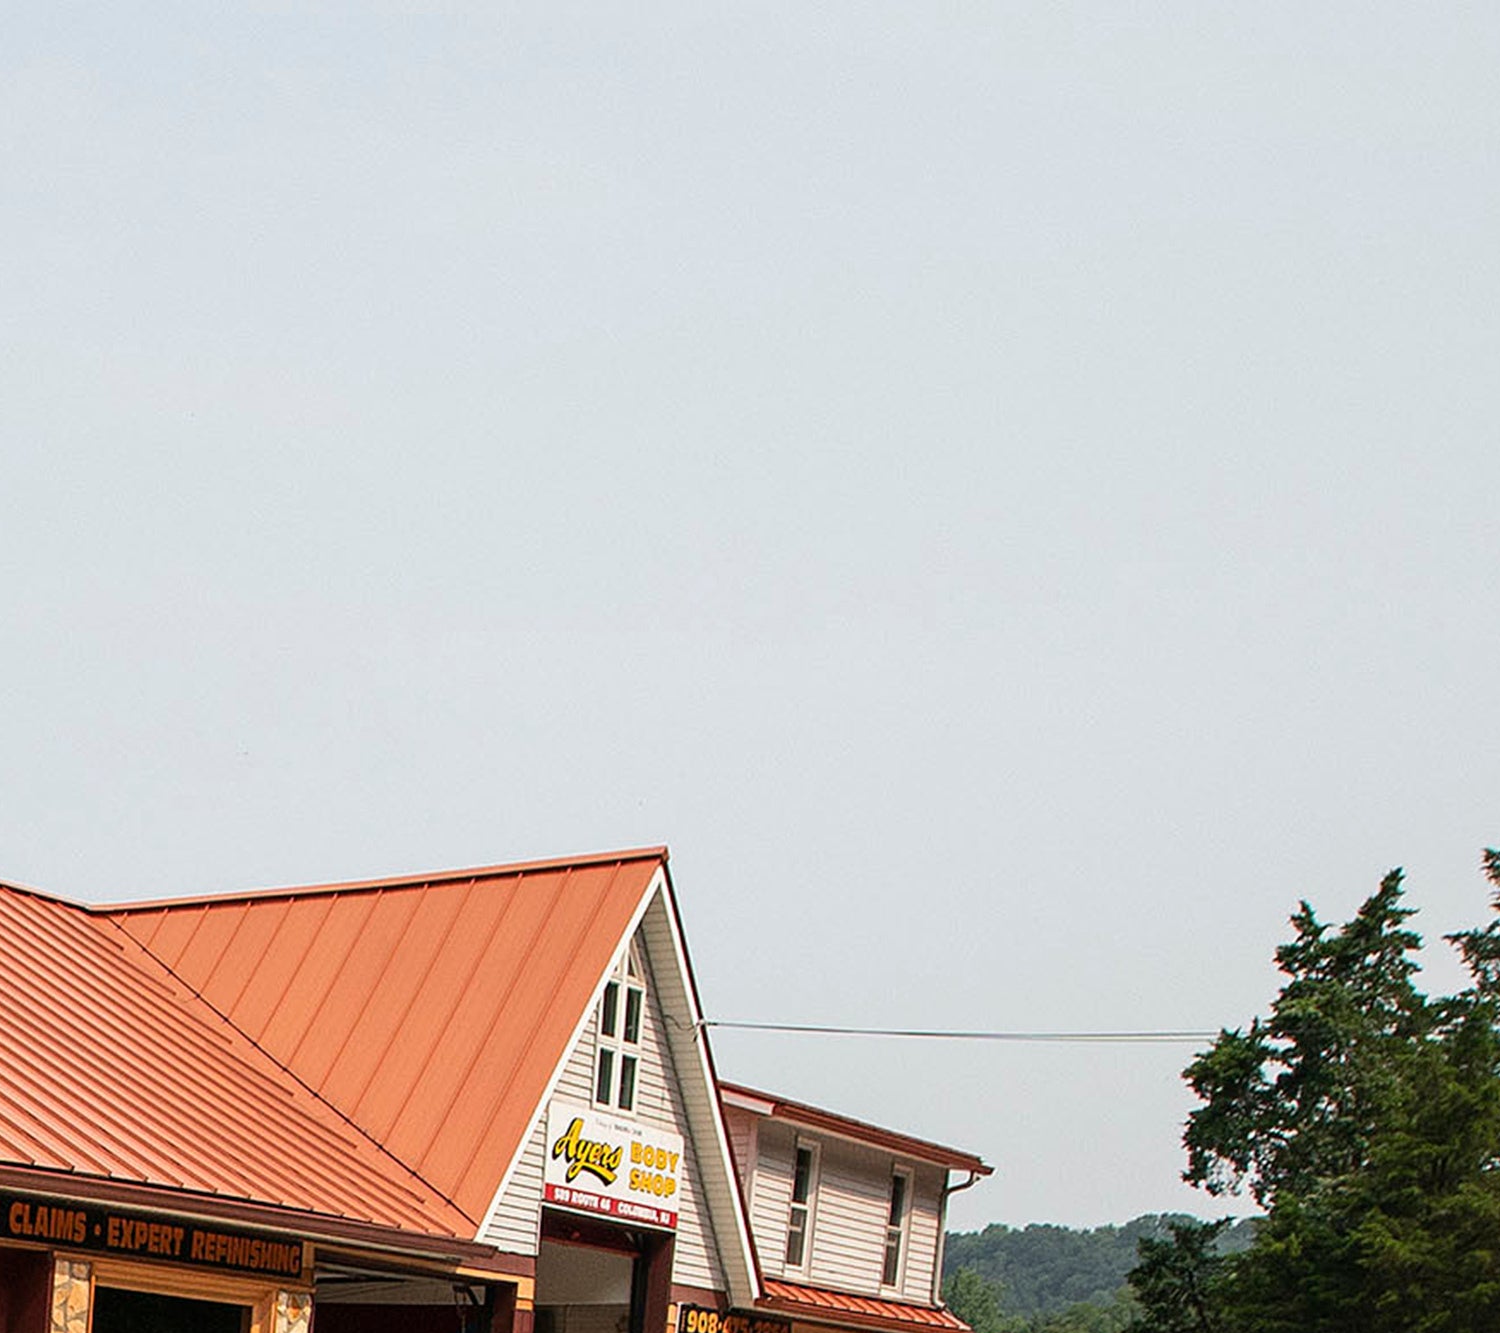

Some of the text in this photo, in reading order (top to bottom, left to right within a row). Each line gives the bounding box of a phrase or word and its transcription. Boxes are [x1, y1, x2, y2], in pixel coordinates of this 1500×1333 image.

[552, 1117, 680, 1186] Ayers BODY
[571, 1191, 599, 1209] ROUTE
[628, 1168, 677, 1198] SHOP
[8, 1201, 88, 1244] CLAIMS
[106, 1216, 184, 1256] EXPERT
[190, 1230, 300, 1274] REFINISHING
